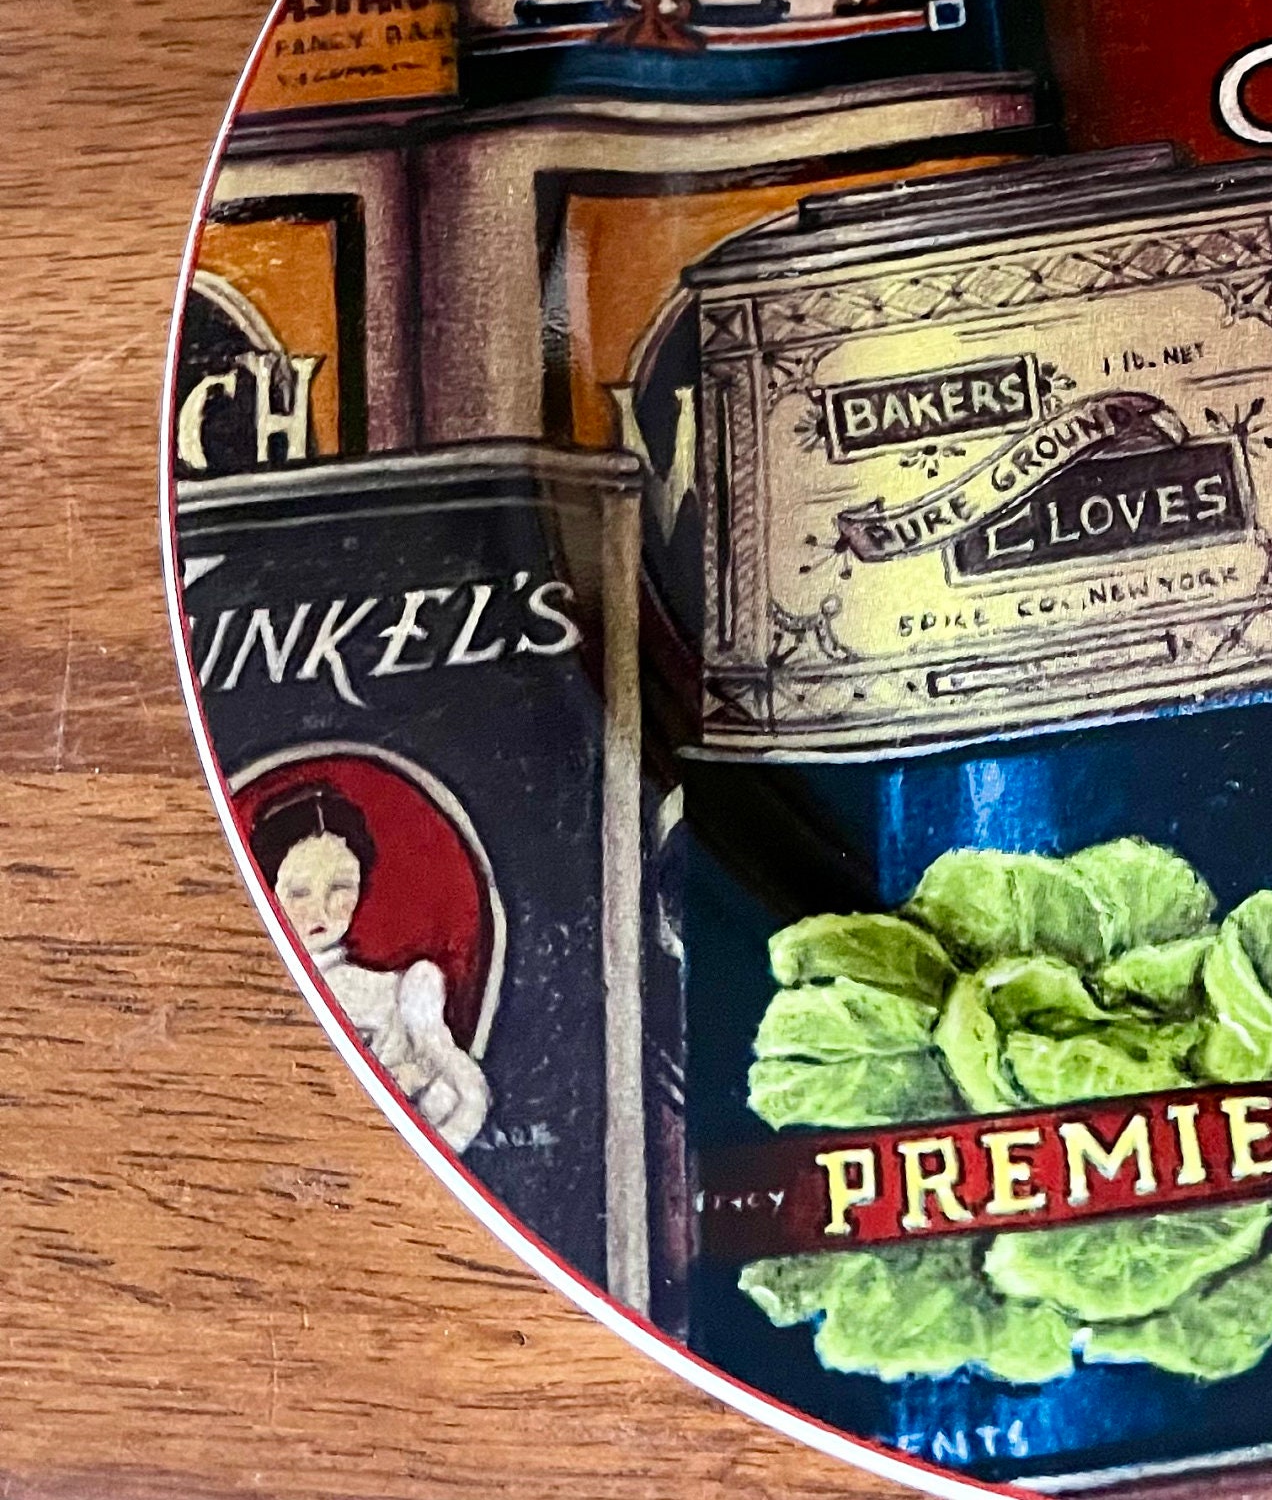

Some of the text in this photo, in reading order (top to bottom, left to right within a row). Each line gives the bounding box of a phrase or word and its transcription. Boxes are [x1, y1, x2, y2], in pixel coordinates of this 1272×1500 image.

[1162, 341, 1205, 366] NET
[843, 371, 1027, 438] BAKERS
[864, 400, 1137, 550] PURE GROUND
[986, 472, 1230, 559] CLOVES
[1089, 575, 1151, 605] NEW
[1157, 565, 1241, 594] YORK
